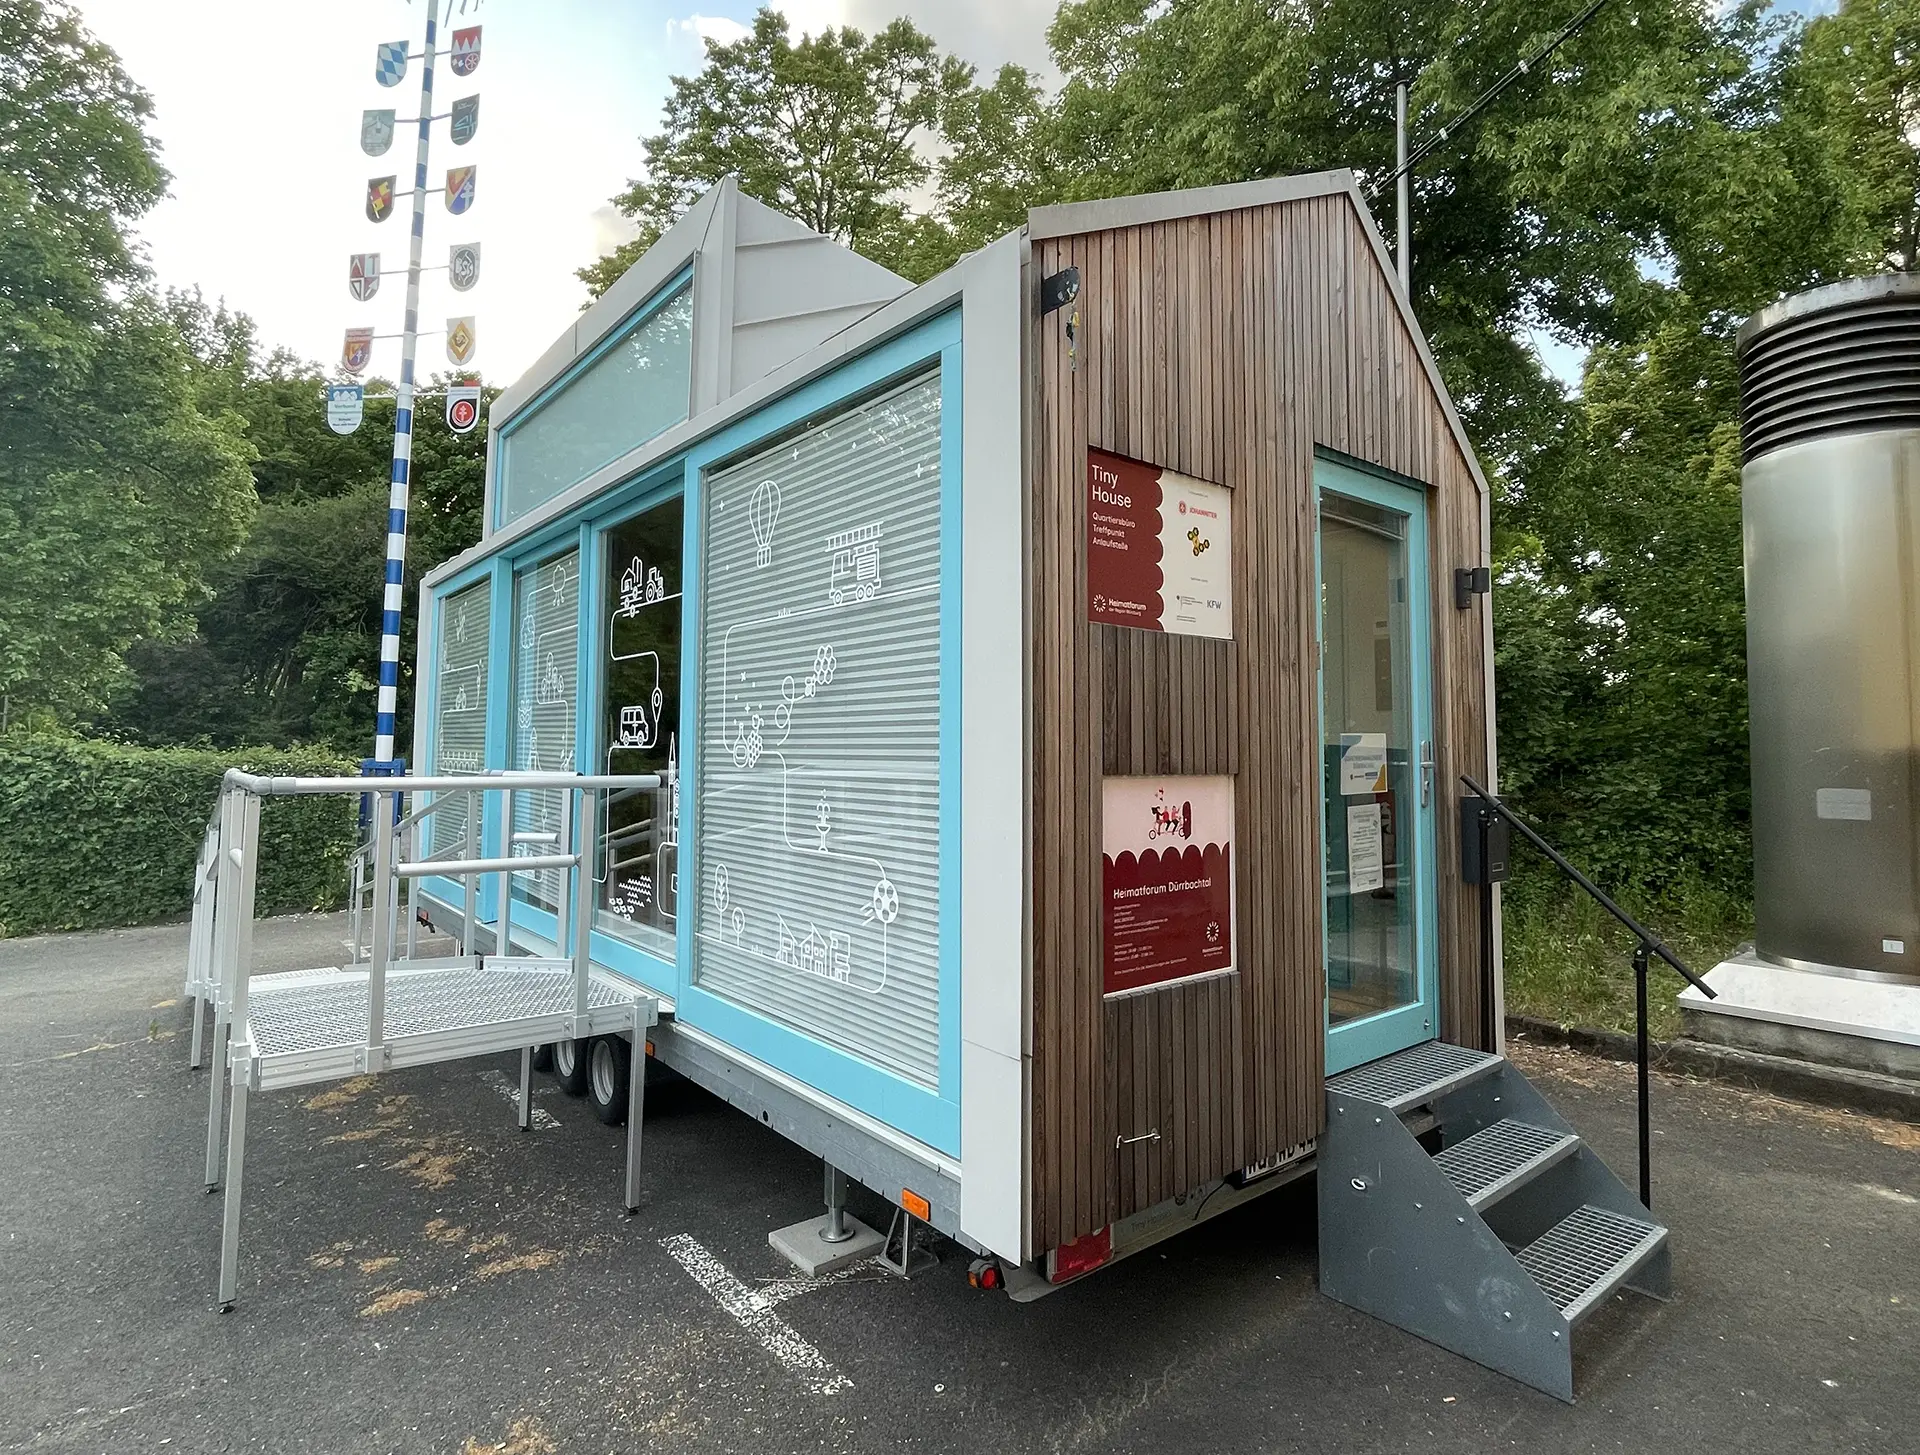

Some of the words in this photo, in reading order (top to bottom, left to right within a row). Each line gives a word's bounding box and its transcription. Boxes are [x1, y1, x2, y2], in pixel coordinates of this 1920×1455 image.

[1091, 464, 1118, 489] Tiny
[1092, 485, 1132, 508] House
[1092, 511, 1136, 528] Quartiersbüro
[1092, 523, 1125, 538] Treffpunkt
[1092, 537, 1129, 551] Anlaufstelle
[1108, 598, 1147, 611] Heimatforum
[1113, 884, 1167, 899] Heimatforum
[1168, 877, 1212, 892] Dürrbachtal
